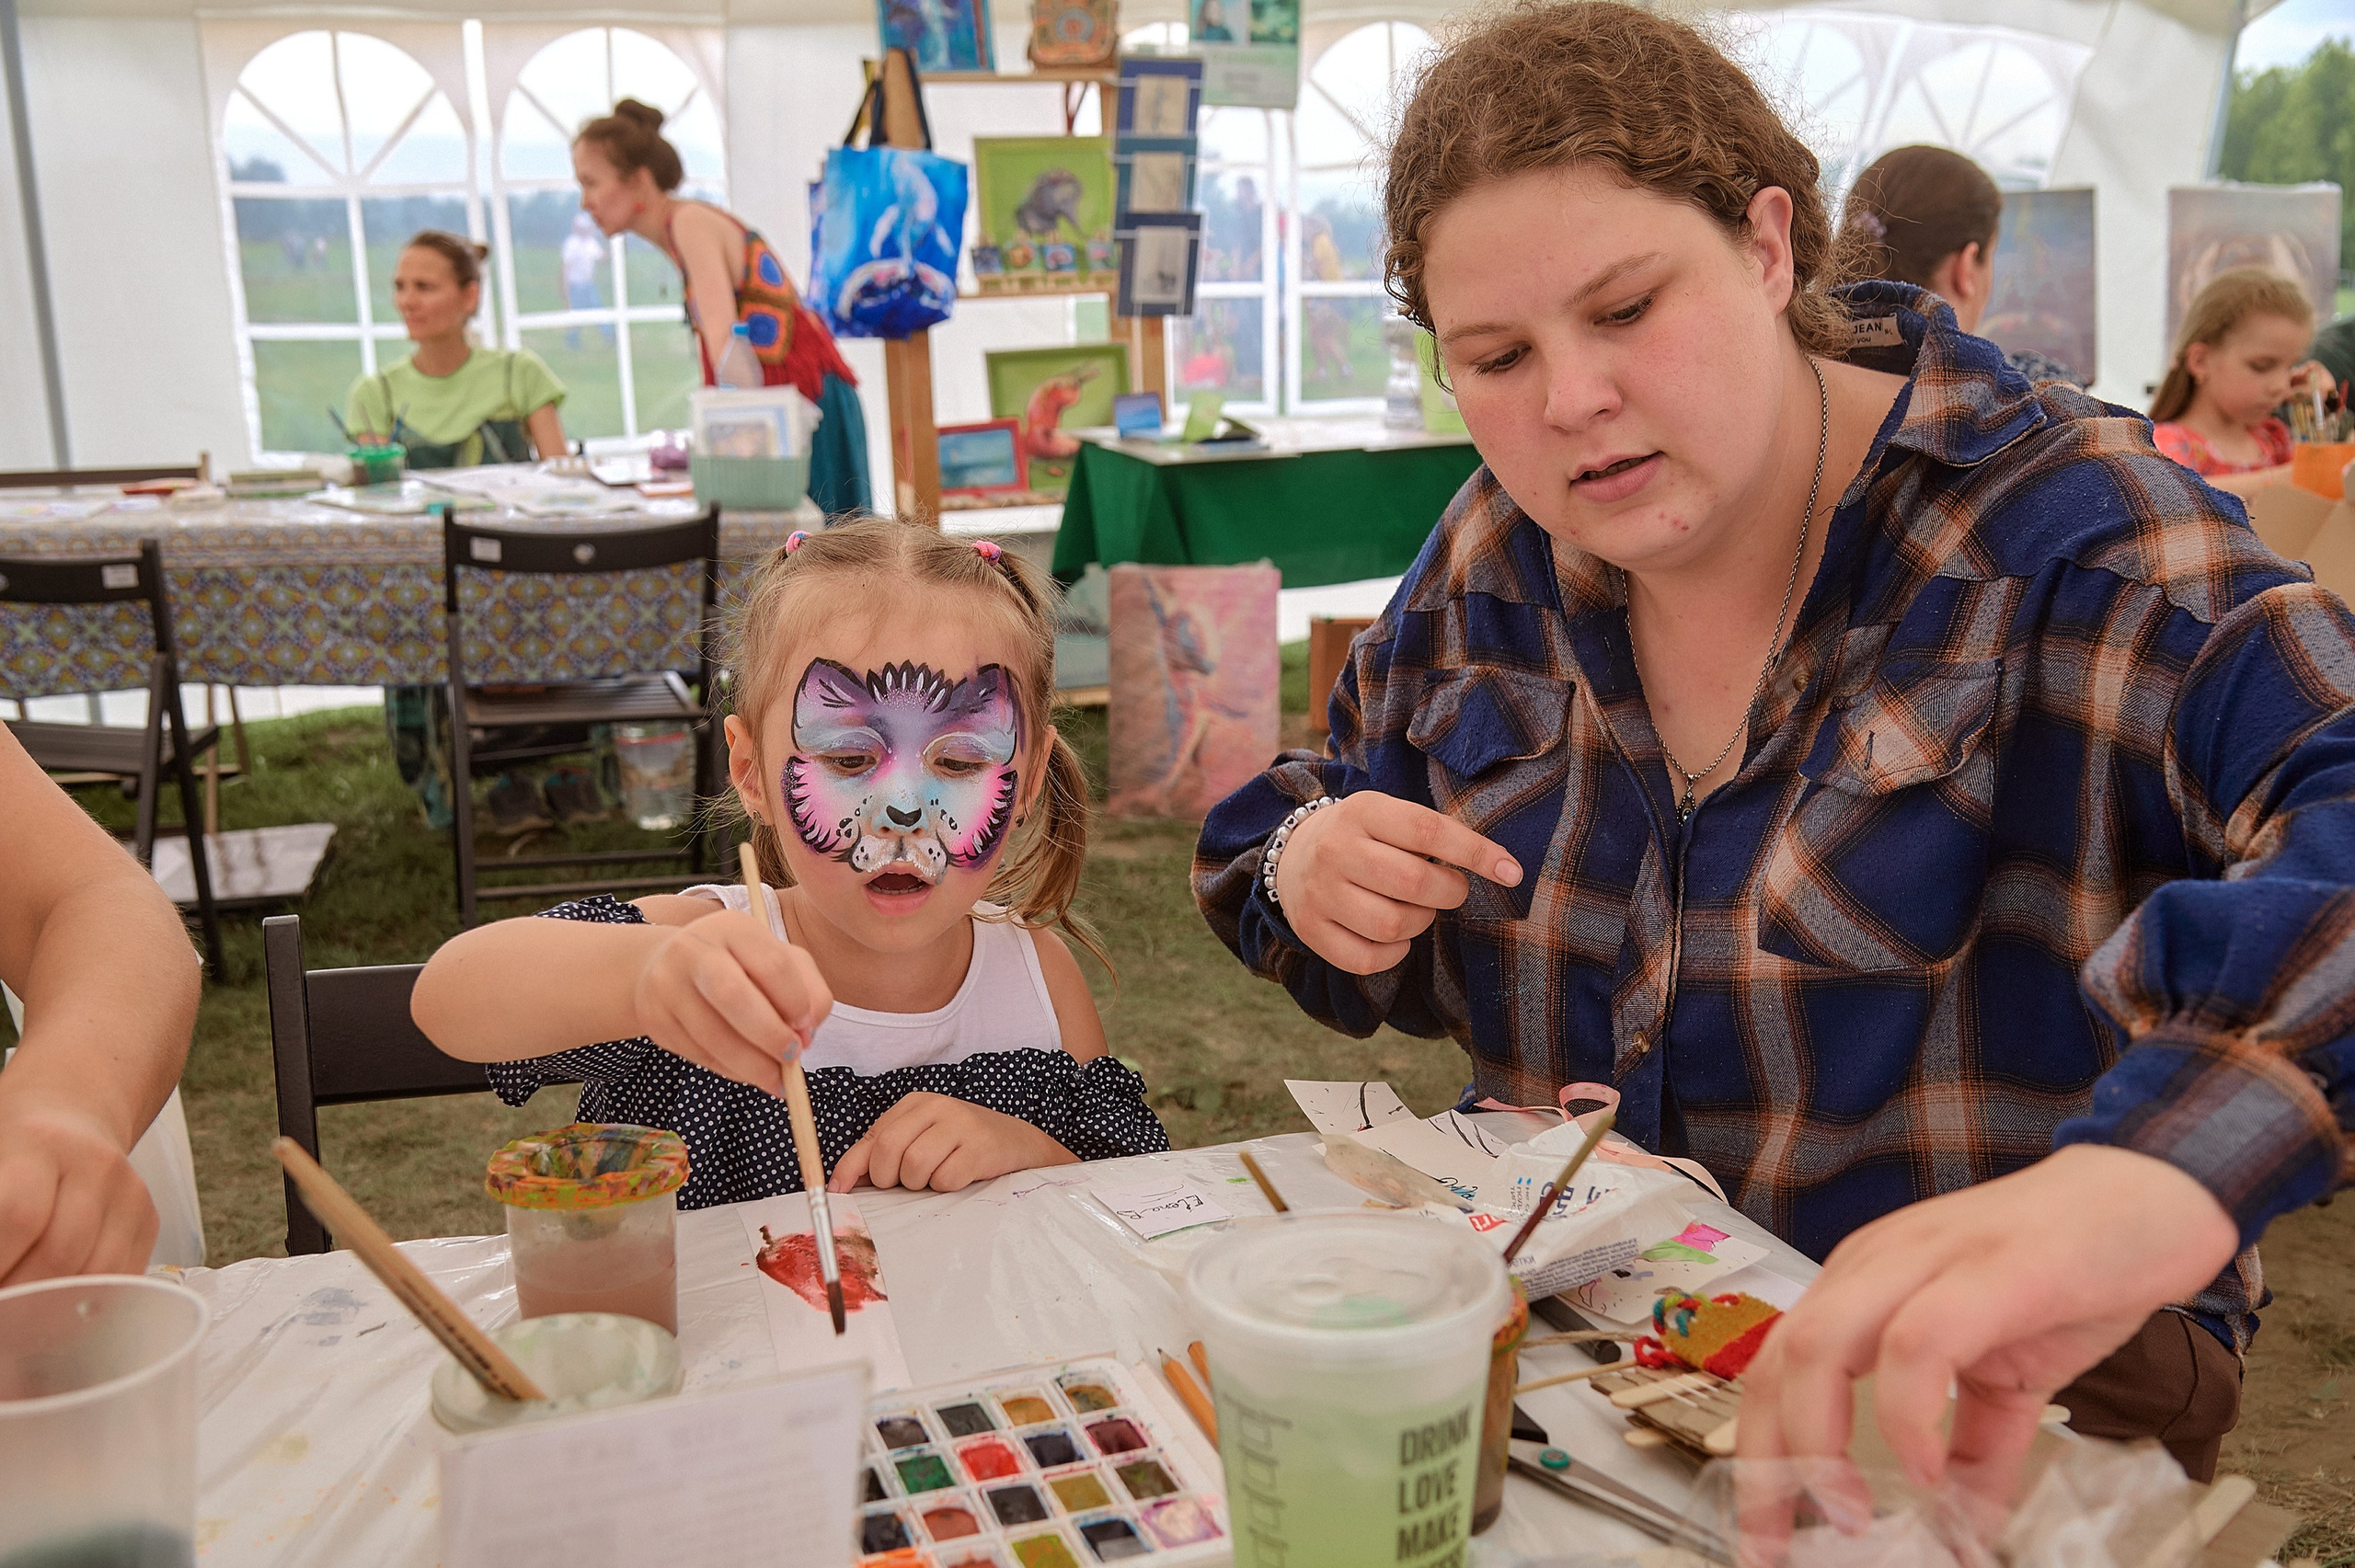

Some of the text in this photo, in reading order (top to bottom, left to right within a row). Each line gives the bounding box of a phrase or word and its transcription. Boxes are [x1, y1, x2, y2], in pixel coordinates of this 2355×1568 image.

[1854, 322, 1882, 334] JEAN
[1400, 1405, 1471, 1466] DRINK
[1398, 1459, 1460, 1514] LOVE
